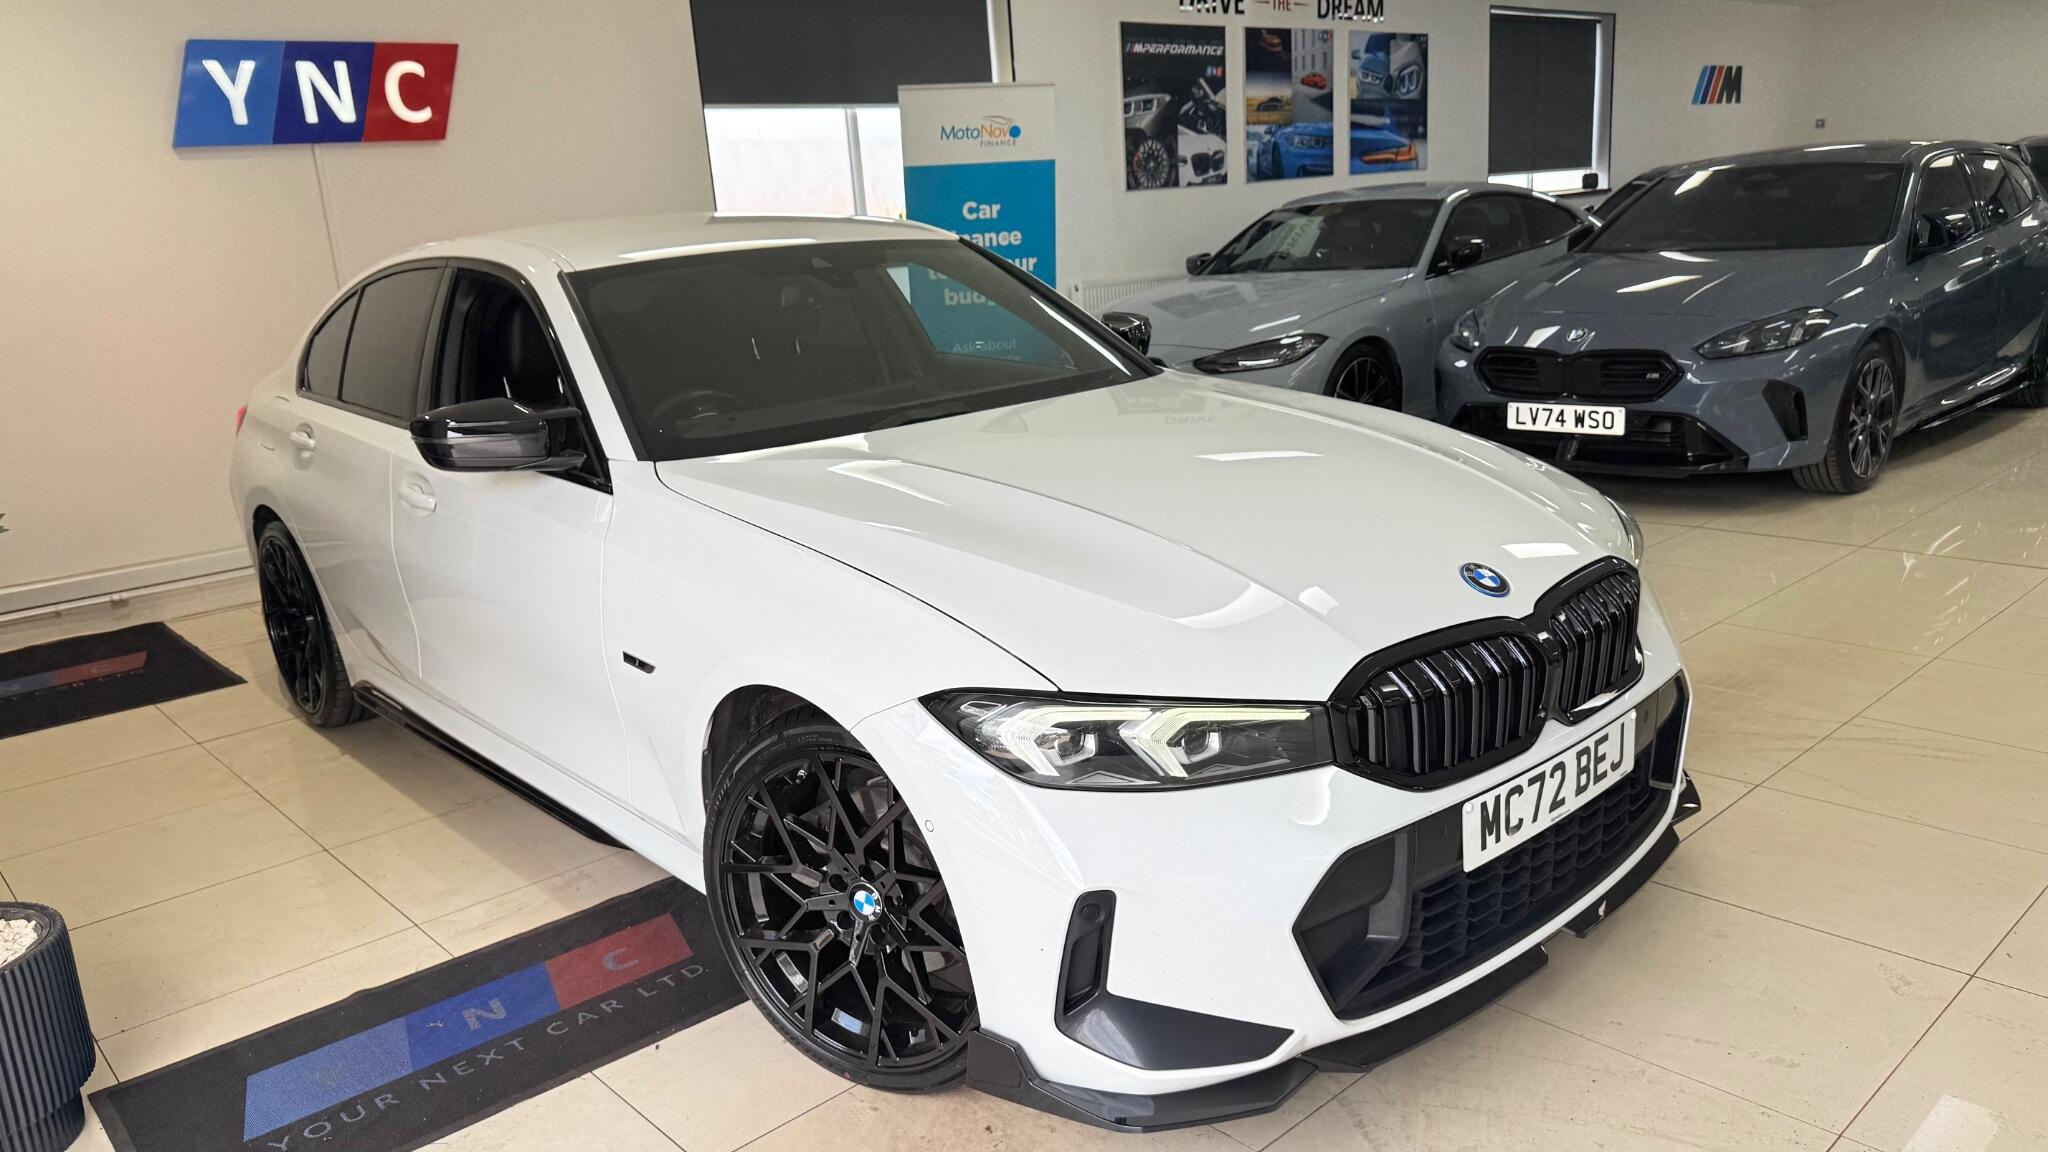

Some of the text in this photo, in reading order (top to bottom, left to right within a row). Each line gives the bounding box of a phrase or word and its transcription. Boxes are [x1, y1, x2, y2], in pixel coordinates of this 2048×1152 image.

[1317, 0, 1384, 22] DREAM
[202, 59, 432, 126] YNC
[980, 139, 1016, 147] FINANCE
[962, 201, 1000, 220] Car
[1515, 406, 1615, 430] LV74 WSO
[1480, 722, 1625, 851] MC72 BEJ
[267, 1093, 399, 1150] YOUR
[419, 1037, 524, 1090] NEXT
[546, 1000, 624, 1036] CAR
